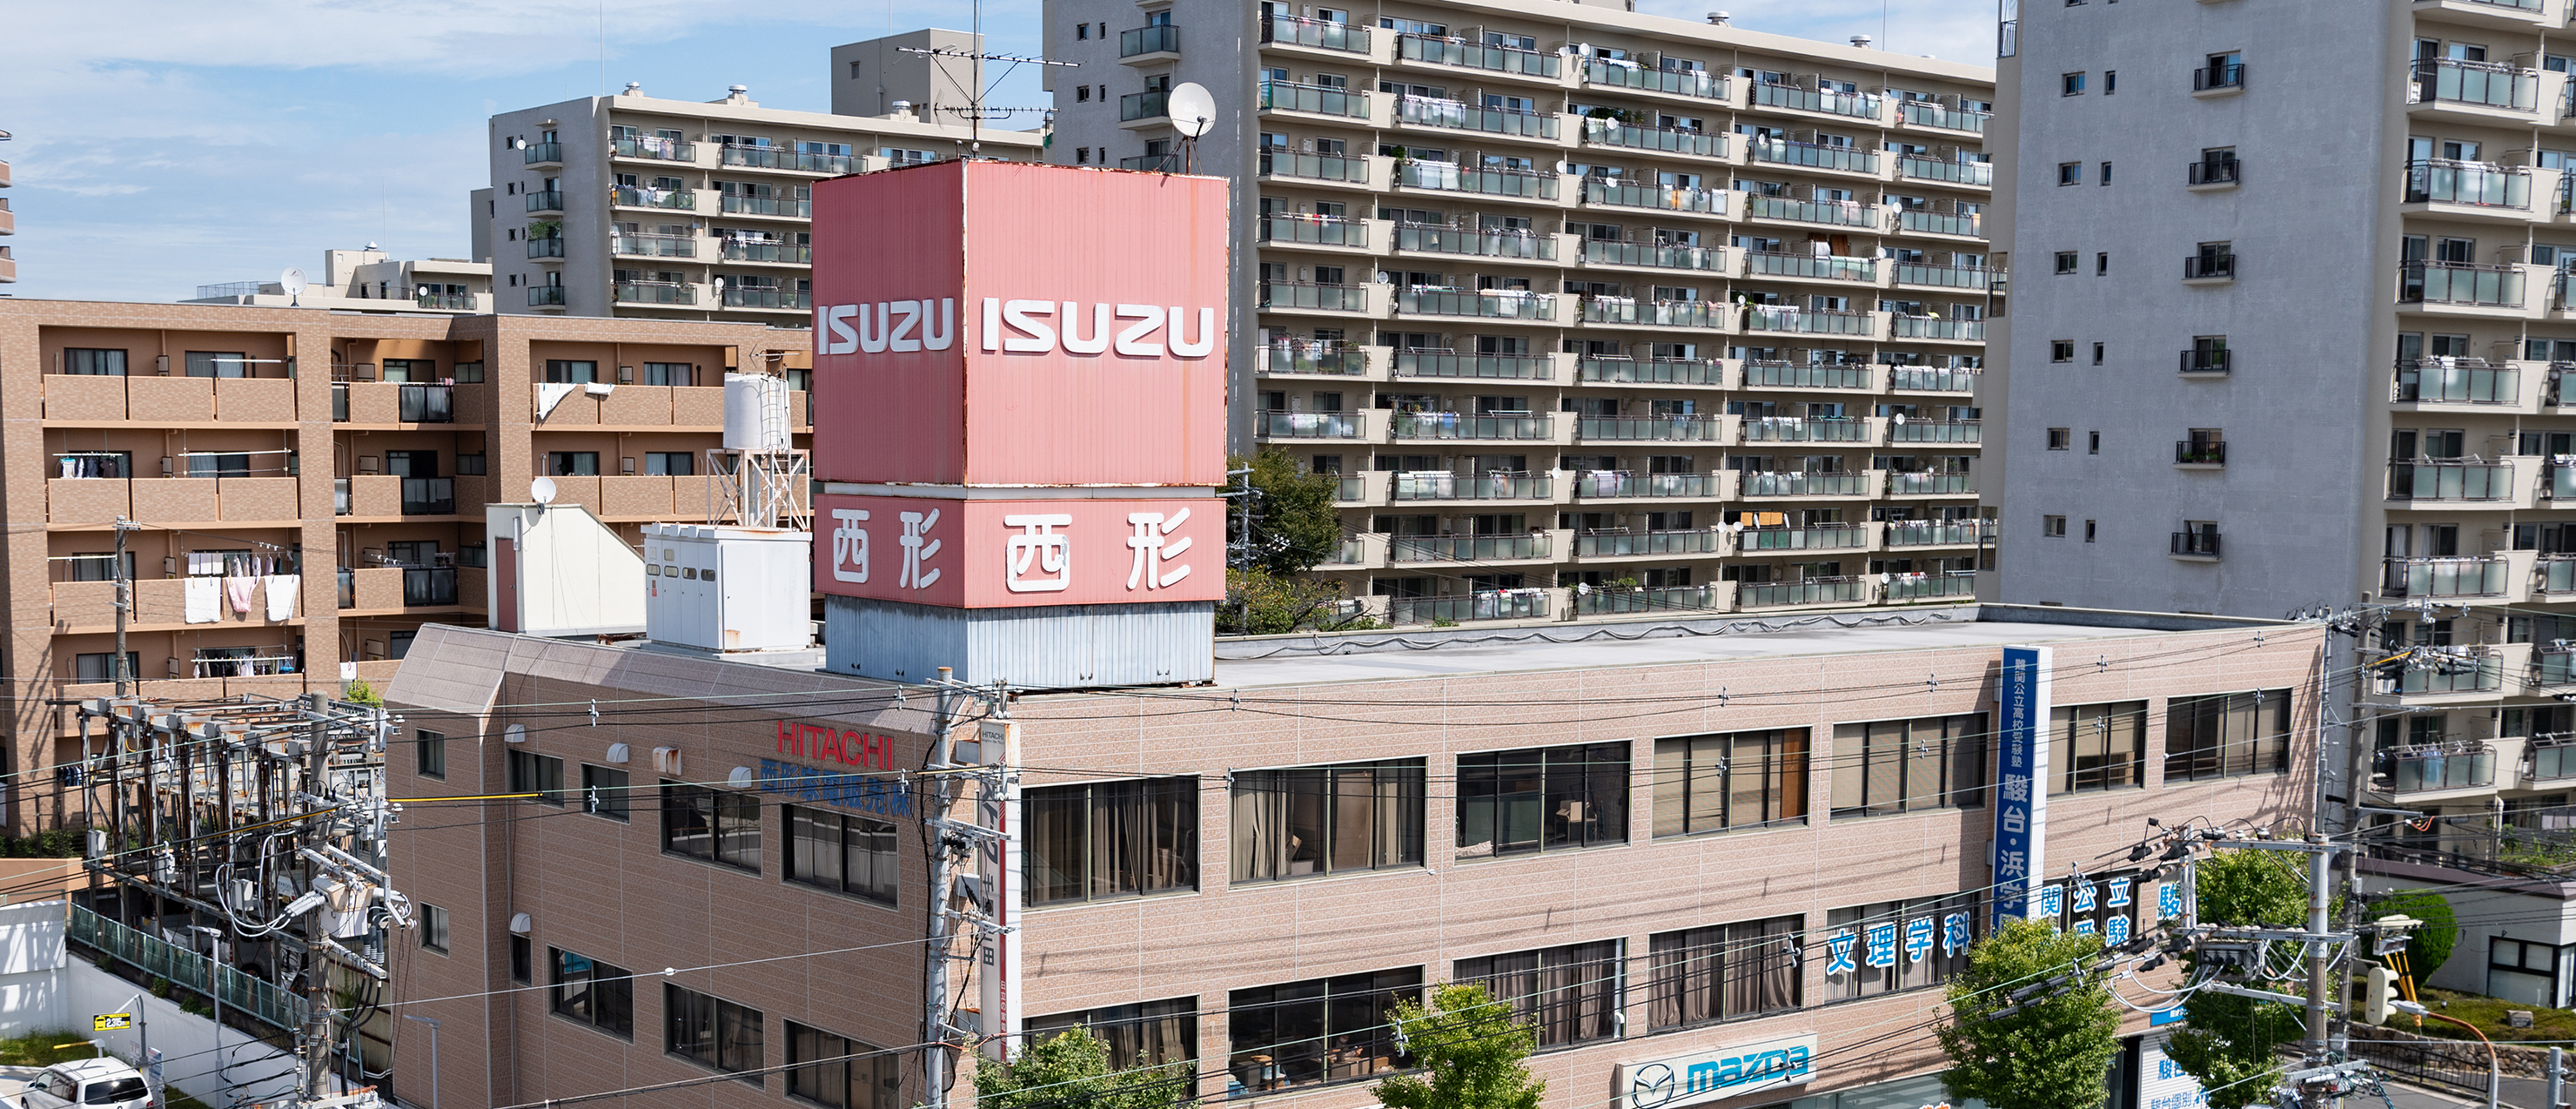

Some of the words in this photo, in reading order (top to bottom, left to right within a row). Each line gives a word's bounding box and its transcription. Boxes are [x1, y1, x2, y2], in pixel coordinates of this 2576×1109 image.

[818, 297, 955, 355] ISUZU
[982, 297, 1215, 357] ISUZU
[832, 507, 941, 588] 西形
[1003, 507, 1191, 593] 西形
[982, 730, 1004, 741] HITACHI
[2011, 658, 2026, 768] 難関公立高校受験塾
[777, 721, 894, 770] HITACHI
[1827, 911, 1971, 976] 文理学科
[1687, 1045, 1809, 1092] mazda
